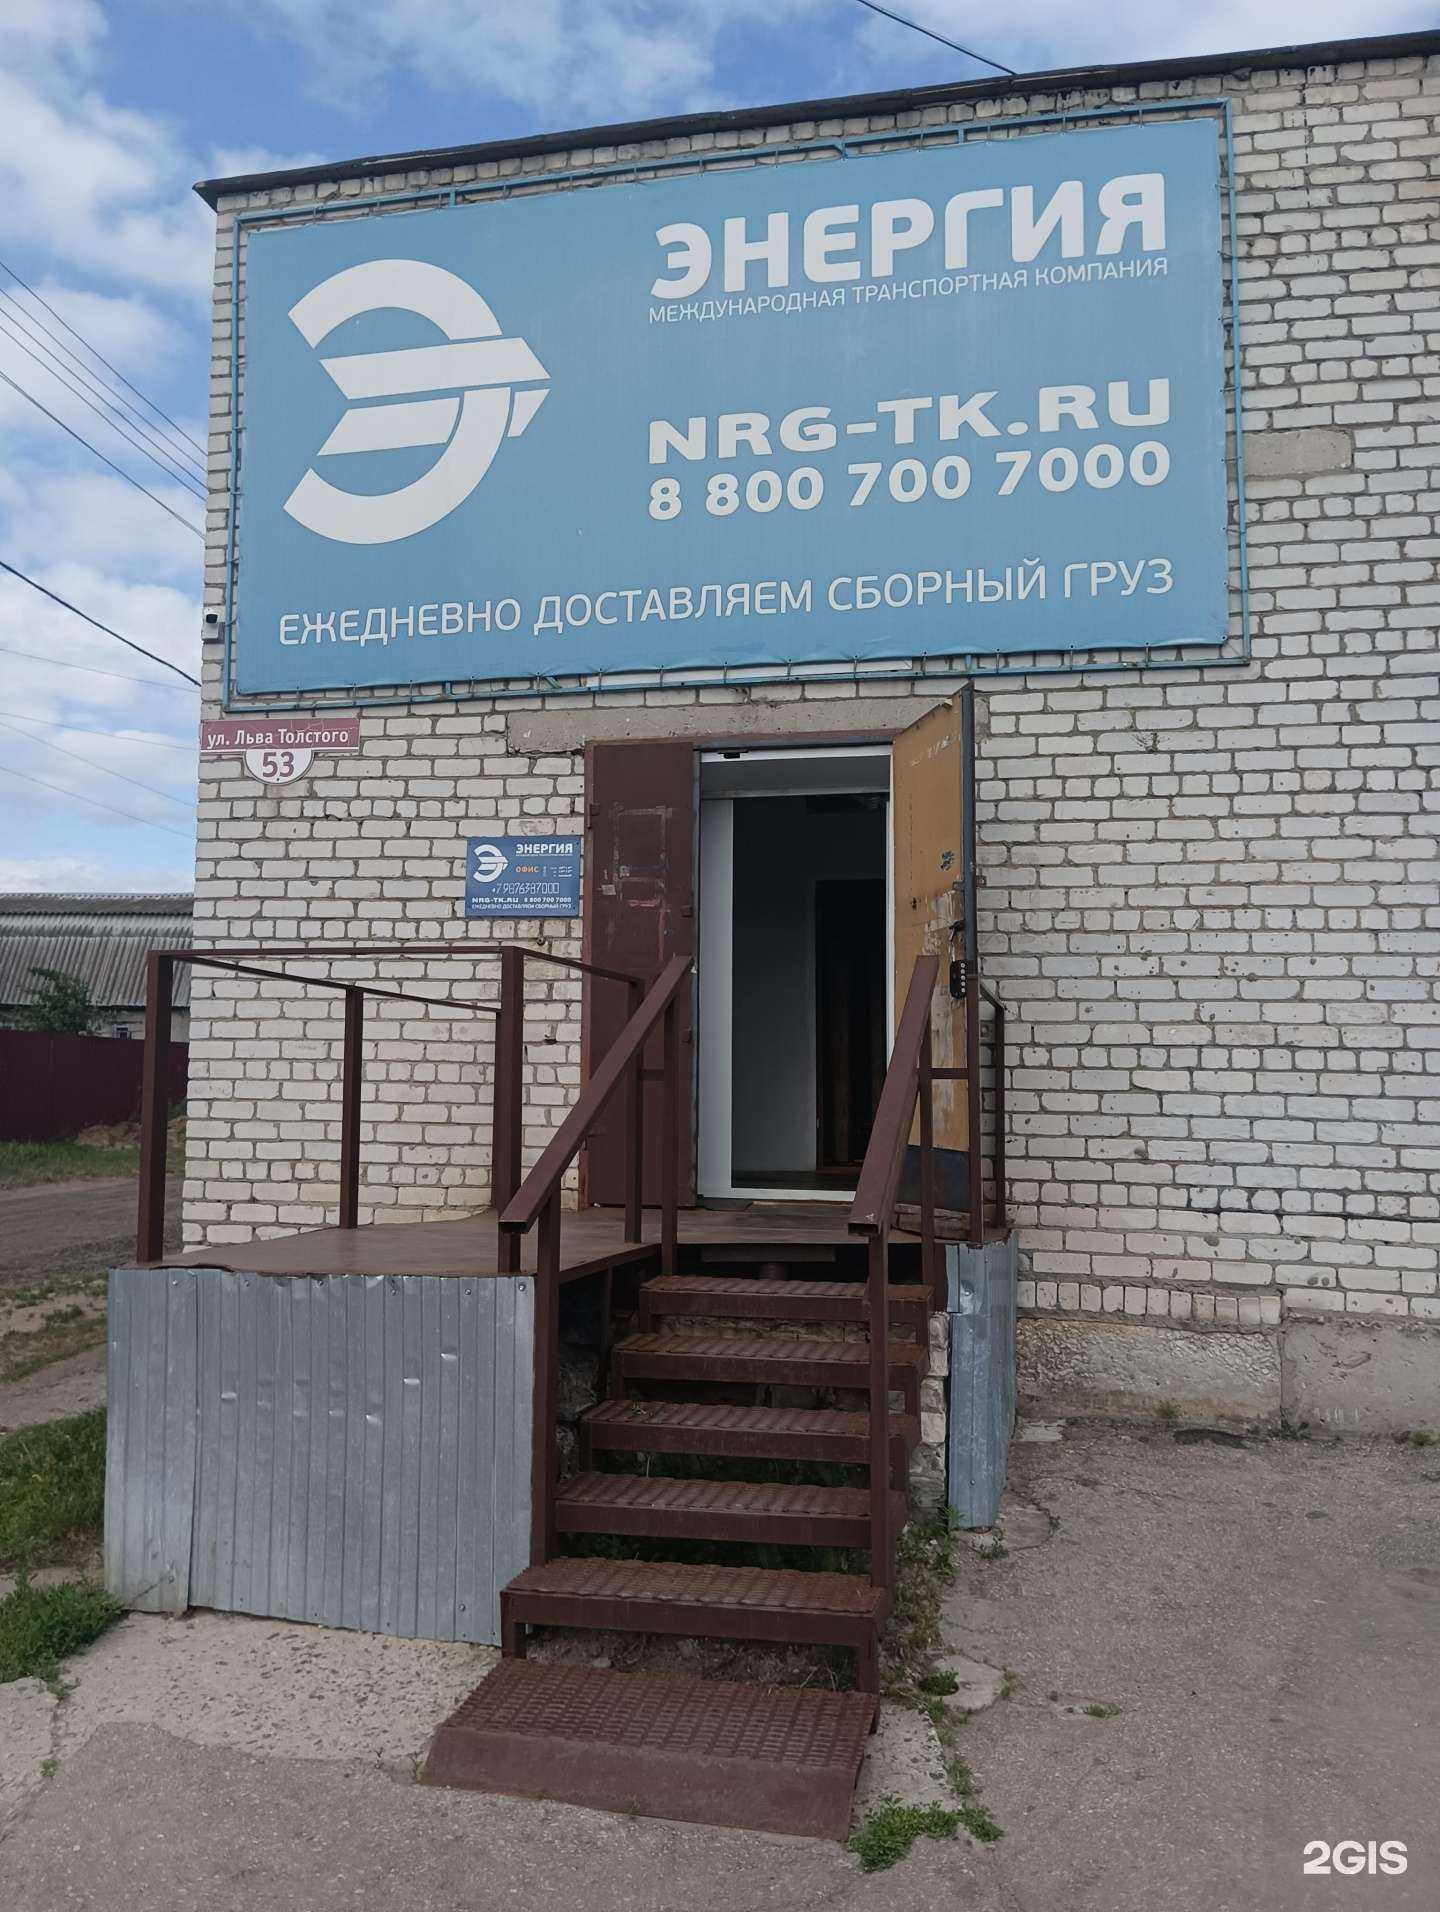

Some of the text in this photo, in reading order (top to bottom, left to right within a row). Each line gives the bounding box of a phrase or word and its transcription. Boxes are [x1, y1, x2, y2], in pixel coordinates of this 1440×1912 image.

[650, 173, 1167, 299] ЭНЕРГИЯ
[648, 257, 1168, 323] МЕЖДУНАРОДНАЯ ТРАНСПОРТНАЯ КОМПАНИЯ
[649, 378, 1170, 464] NRG-TK.RU
[648, 440, 1170, 520] 8 800 700 7000
[279, 558, 1173, 647] ЕЖЕДНЕВНО ДОСТАВЛЯЕМ СБОРНЫЙ ГРУЗ
[207, 728, 348, 749] ул. Льва Толстого
[262, 752, 294, 778] 53
[515, 843, 573, 854] ЭНЕРГИЯ
